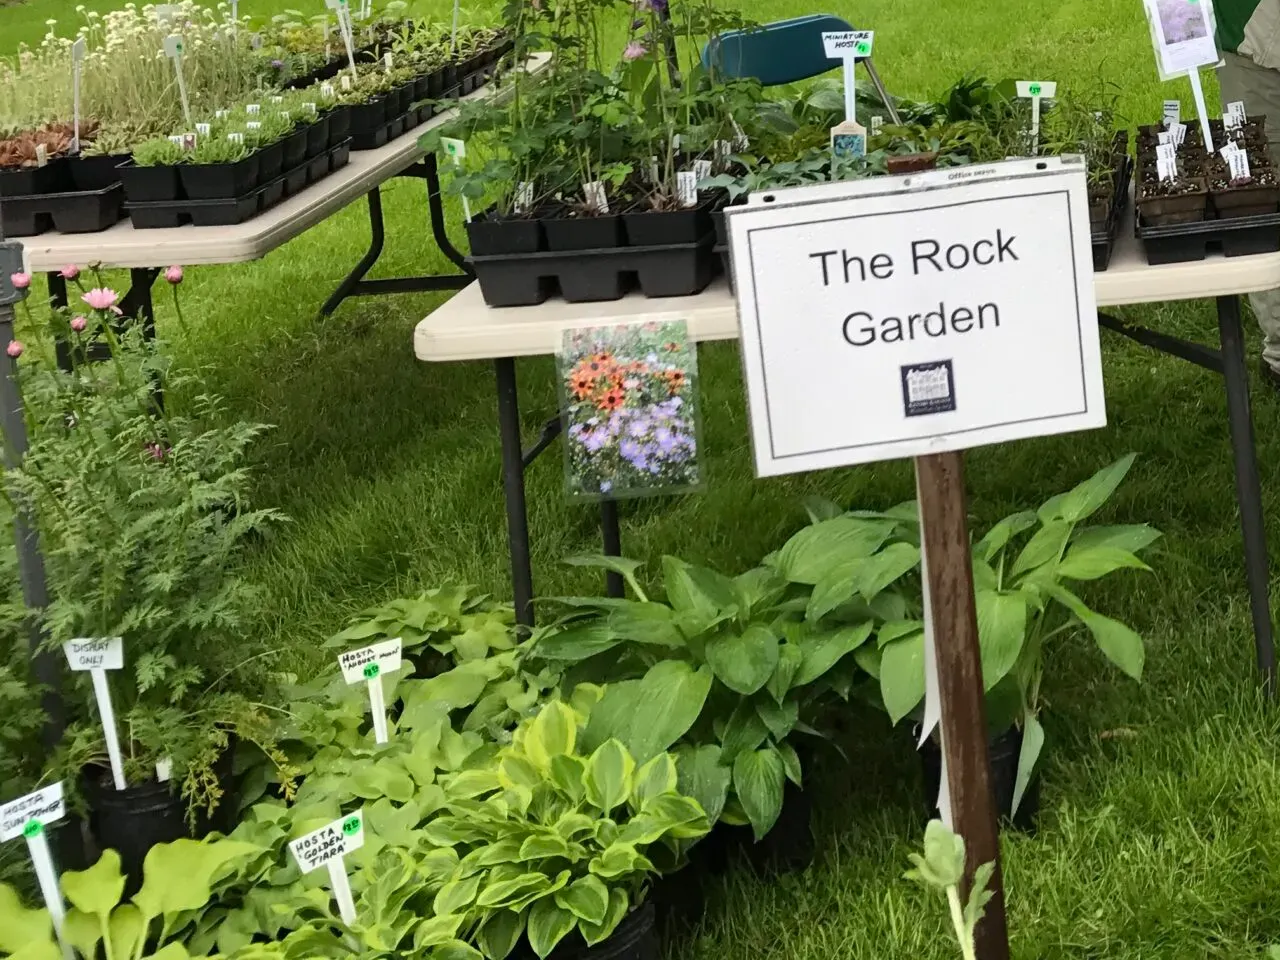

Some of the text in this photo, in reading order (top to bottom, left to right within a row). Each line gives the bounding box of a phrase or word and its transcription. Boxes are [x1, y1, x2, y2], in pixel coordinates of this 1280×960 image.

[824, 32, 870, 41] MINIATURE
[948, 170, 972, 180] Office
[809, 228, 1020, 287] The Rock
[841, 300, 1001, 347] Garden
[79, 654, 104, 665] ONLY
[342, 648, 374, 664] HOSTA
[3, 793, 44, 817] HOSTA
[2, 817, 25, 832] SUN
[296, 827, 335, 853] HOSTA
